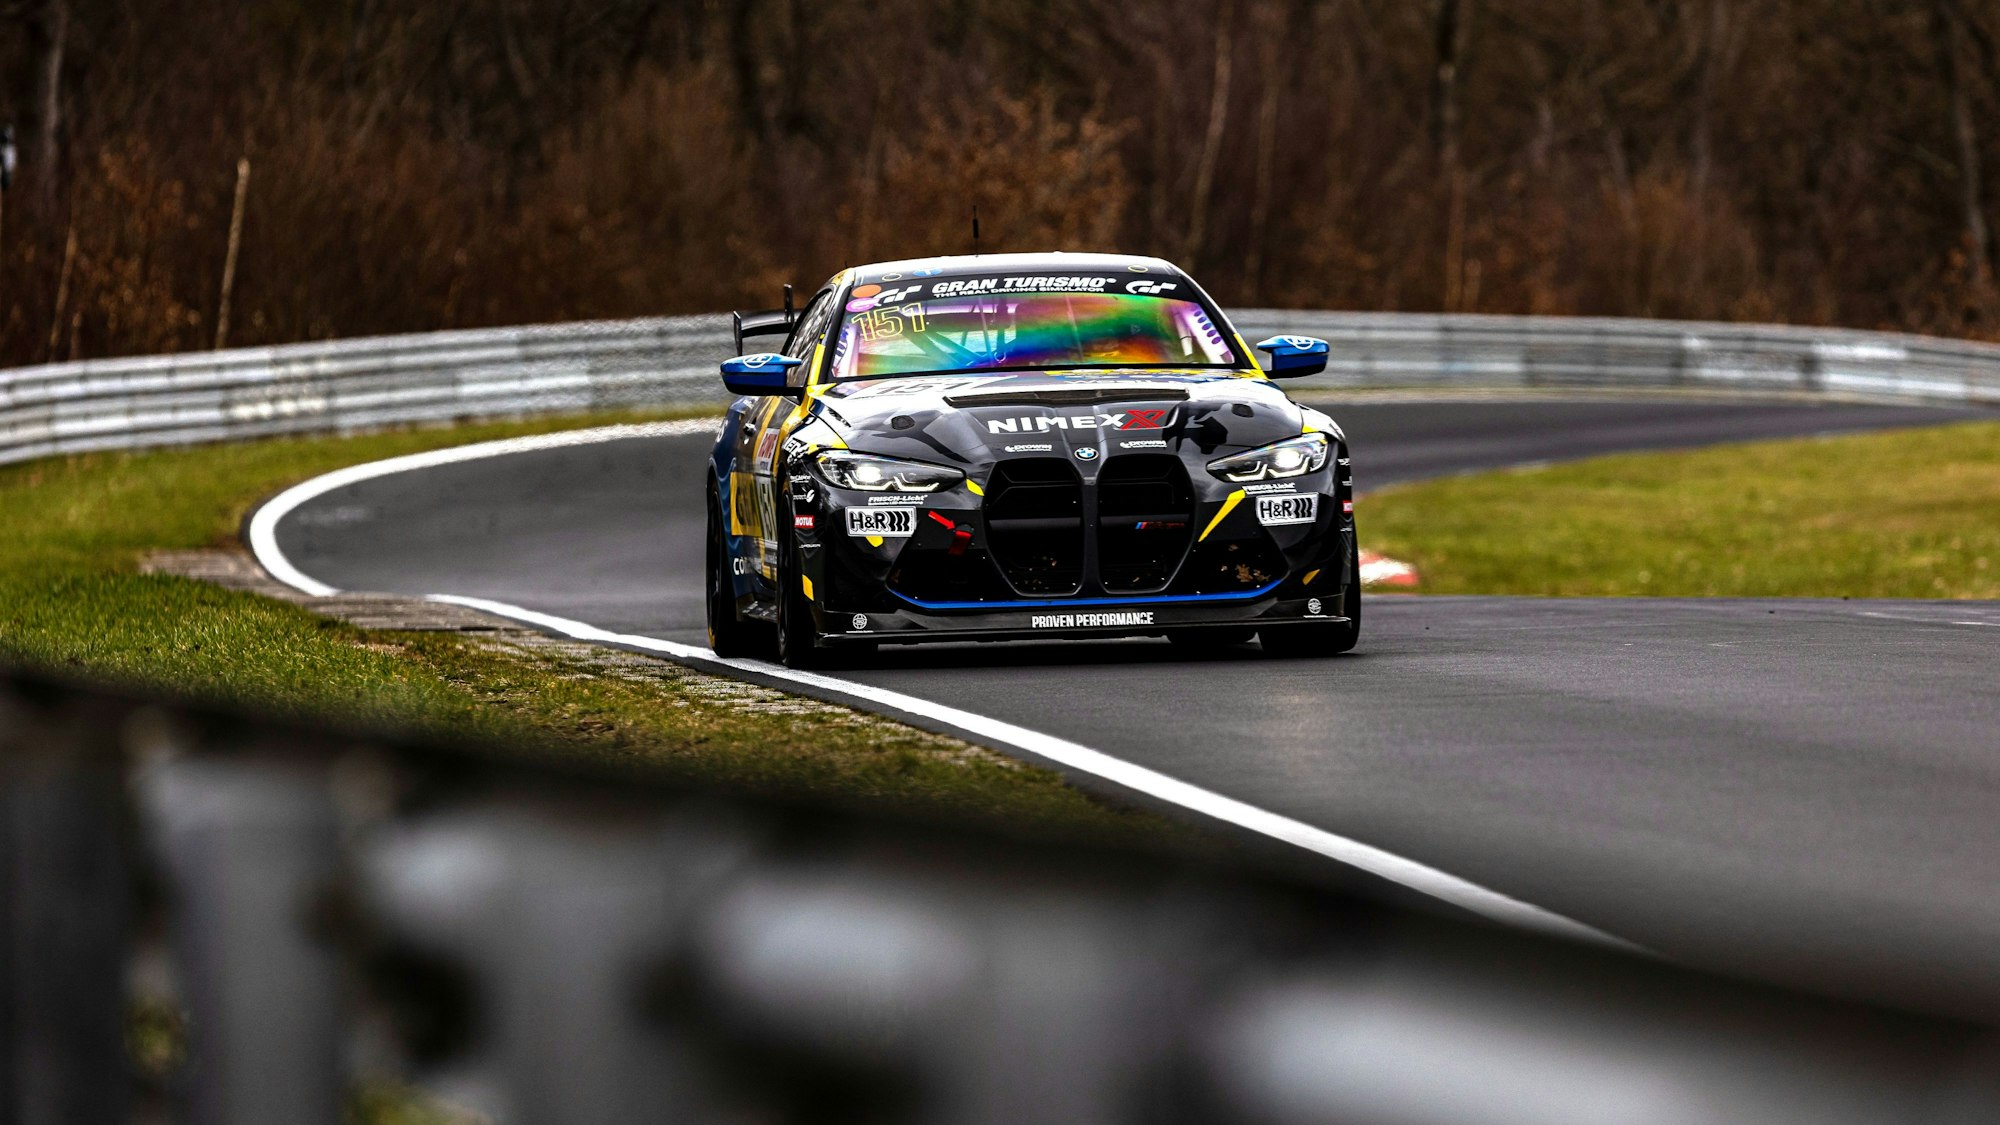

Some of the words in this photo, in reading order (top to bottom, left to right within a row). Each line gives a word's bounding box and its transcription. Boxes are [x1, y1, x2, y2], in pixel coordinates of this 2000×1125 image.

[932, 279, 998, 294] GRAN
[851, 302, 926, 342] 151
[794, 517, 814, 526] MOTUL
[1031, 615, 1075, 628] PROVEN
[1076, 612, 1154, 626] PERFORMANCE
